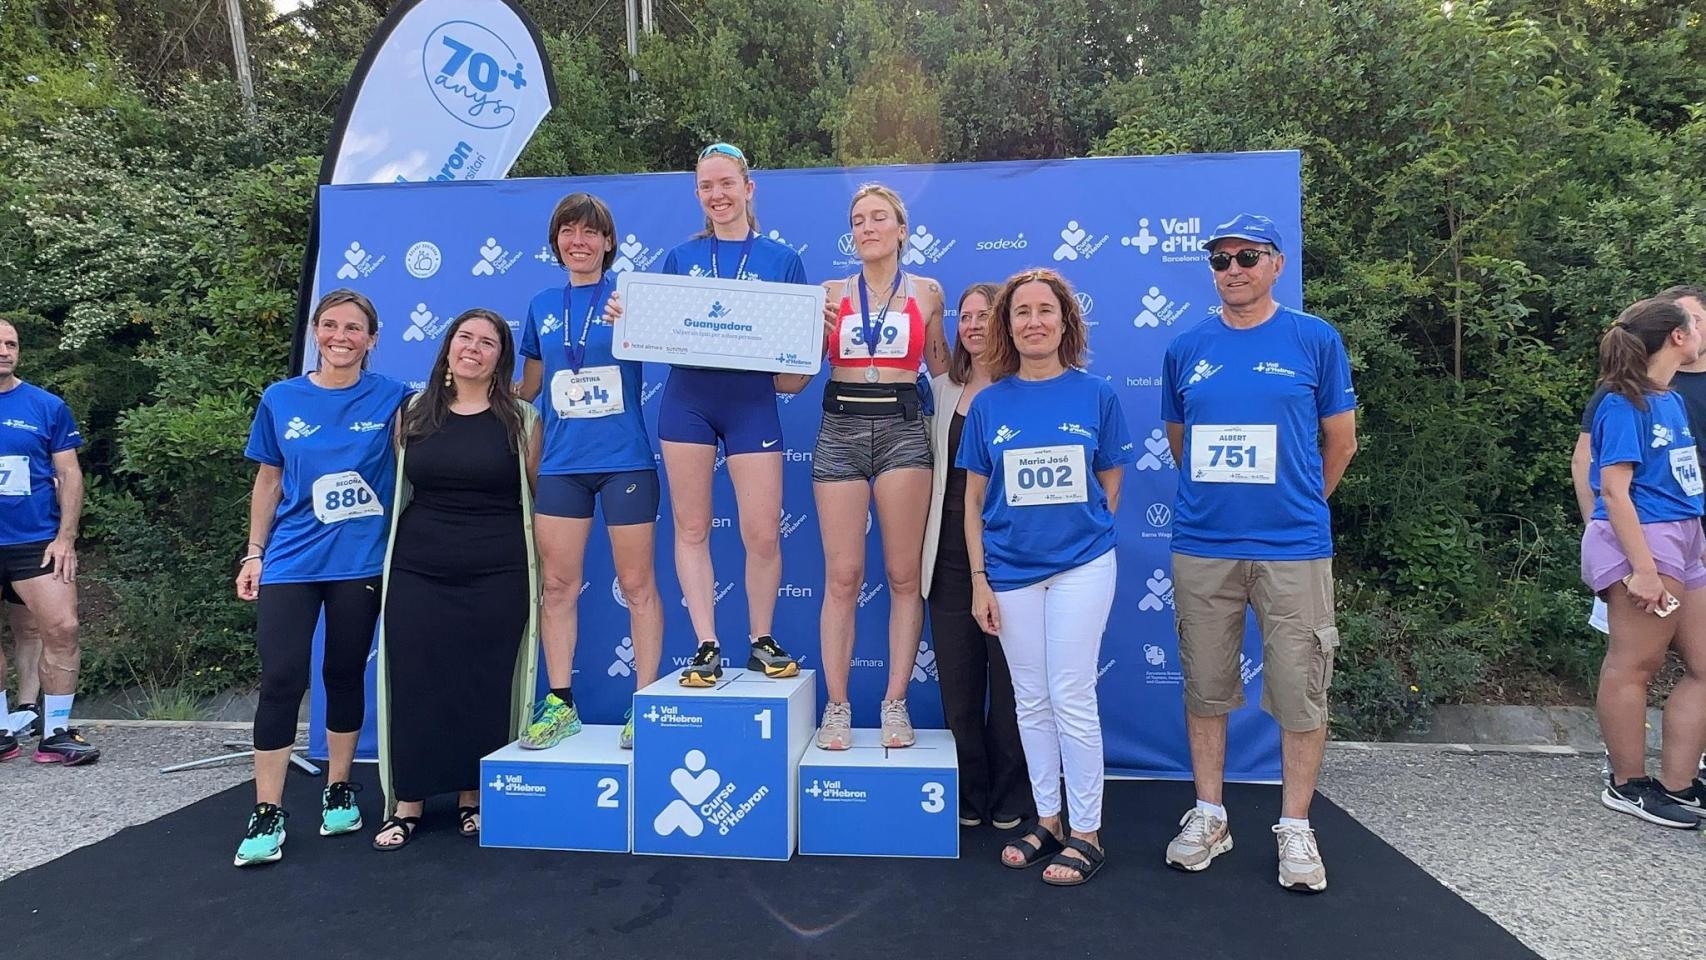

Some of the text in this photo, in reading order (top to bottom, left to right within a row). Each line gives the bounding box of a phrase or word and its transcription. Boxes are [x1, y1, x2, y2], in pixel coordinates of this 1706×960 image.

[441, 35, 500, 92] 70
[435, 75, 503, 116] anys
[1160, 217, 1200, 234] Vall
[976, 238, 1028, 250] sodexo
[1162, 255, 1200, 263] Barcelona
[683, 318, 753, 331] Guanyadora
[1126, 376, 1151, 386] hotel
[1019, 455, 1069, 466] Maria José
[1208, 445, 1257, 468] 751
[1018, 465, 1073, 490] 002
[325, 487, 372, 511] 880
[850, 657, 883, 667] alimara
[660, 706, 678, 714] Vall
[660, 714, 703, 723] d'Hebron
[754, 709, 771, 739] 1
[505, 775, 522, 783] Vall
[823, 780, 841, 788] Vall
[505, 783, 546, 793] d'Hebron
[597, 777, 619, 808] 2
[823, 789, 866, 798] d'Hebron
[700, 782, 736, 816] Cursa
[921, 782, 945, 813] 3
[707, 801, 733, 825] Vall
[719, 785, 769, 836] d'Hebron
